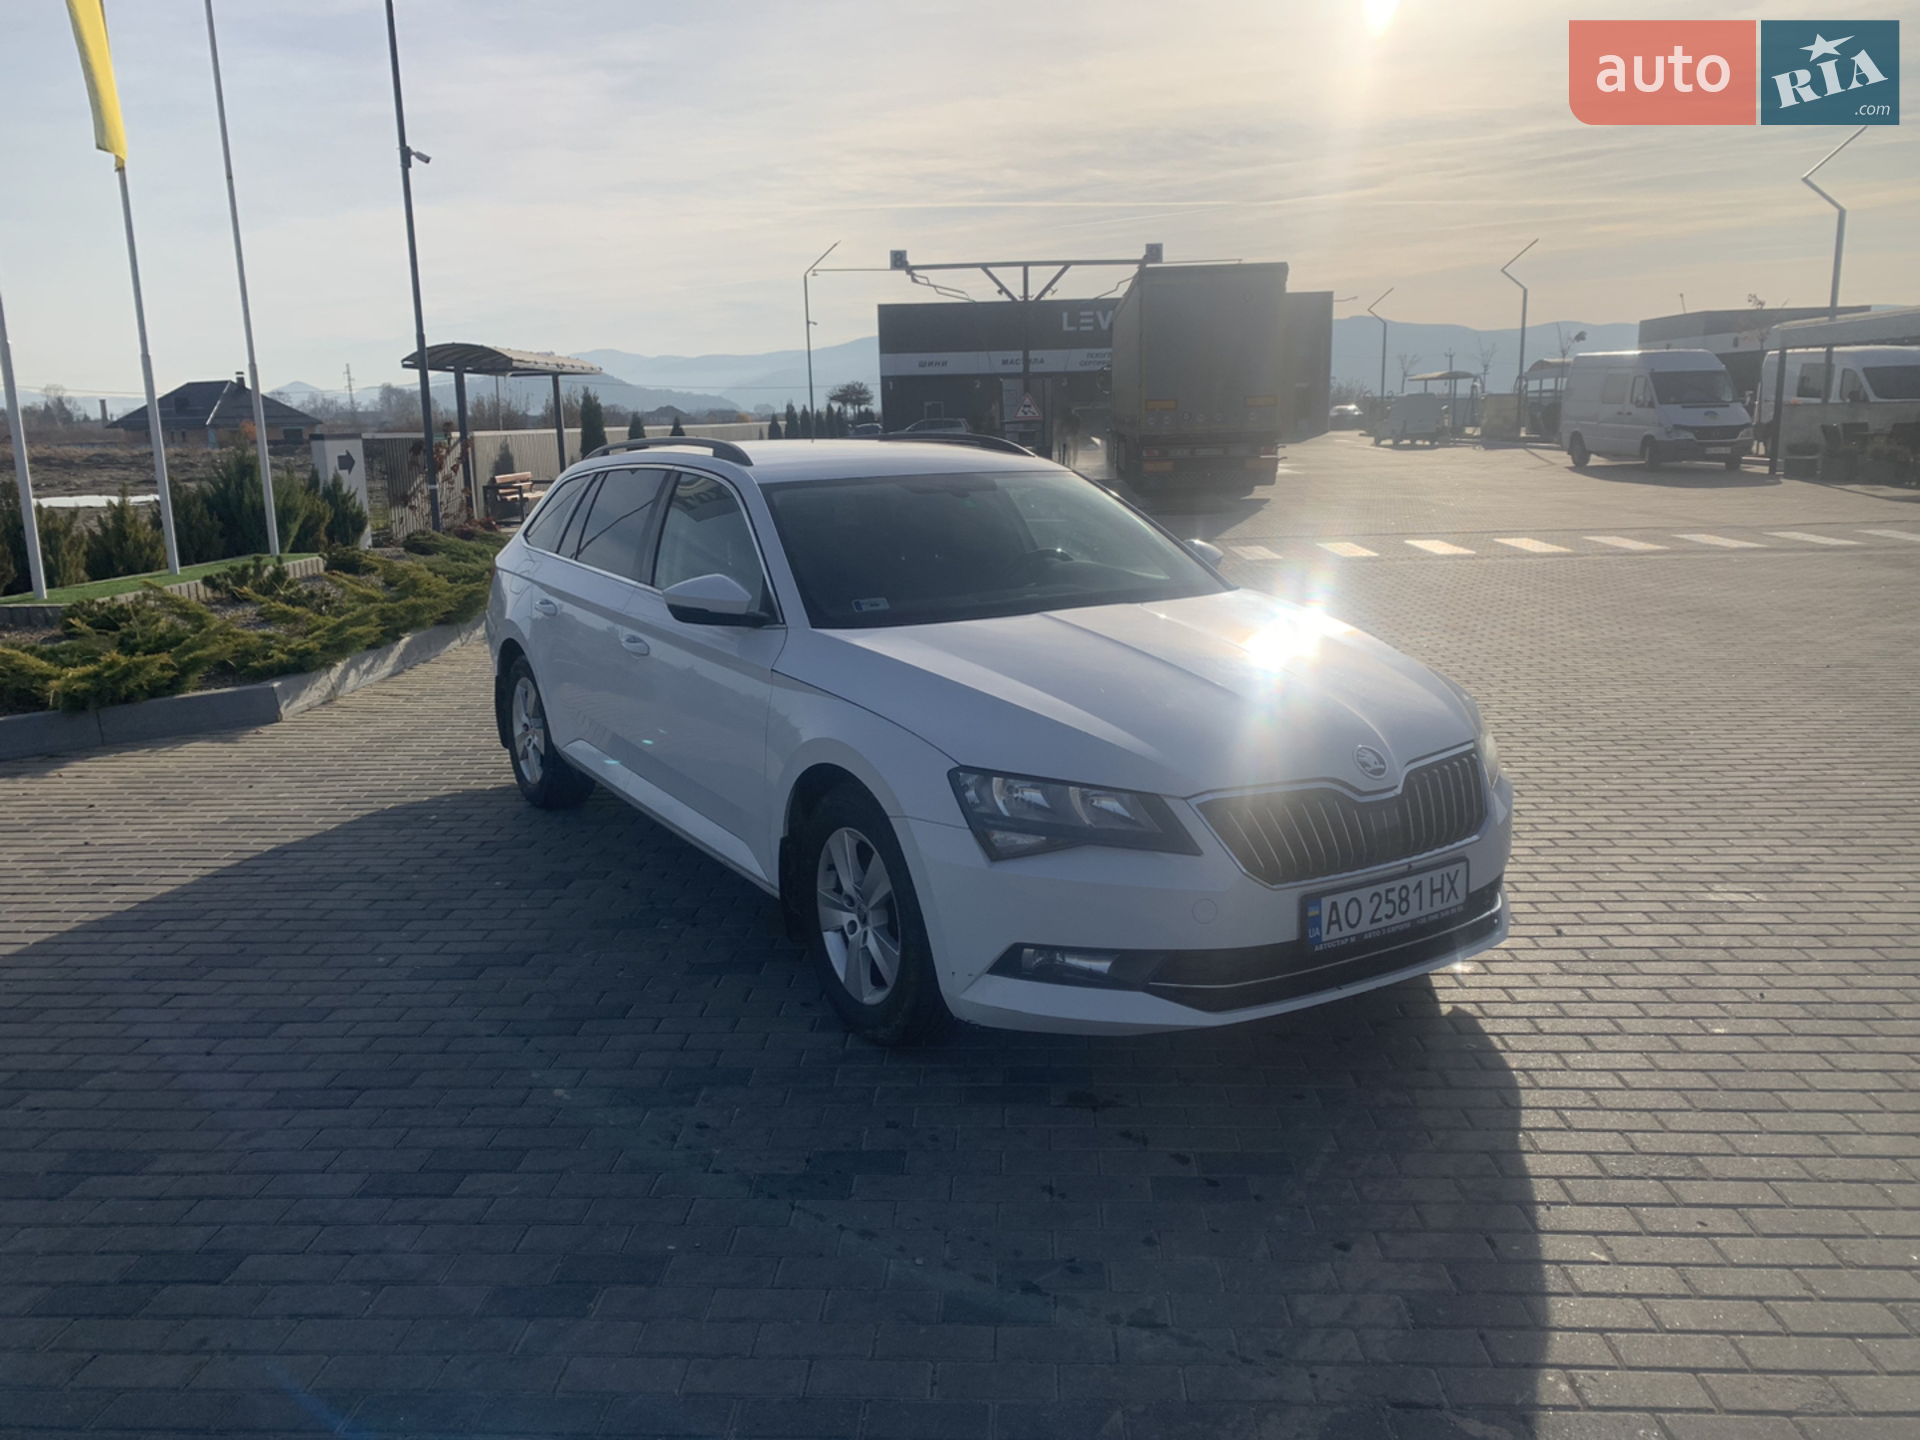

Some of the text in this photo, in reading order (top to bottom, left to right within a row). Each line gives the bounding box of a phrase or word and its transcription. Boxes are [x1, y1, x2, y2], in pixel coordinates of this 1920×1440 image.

[893, 251, 903, 268] 8
[918, 360, 948, 368] ШИНИ
[1001, 357, 1045, 365] МАСЛА
[1326, 869, 1460, 935] AO 2581 HX
[1308, 926, 1321, 939] UA
